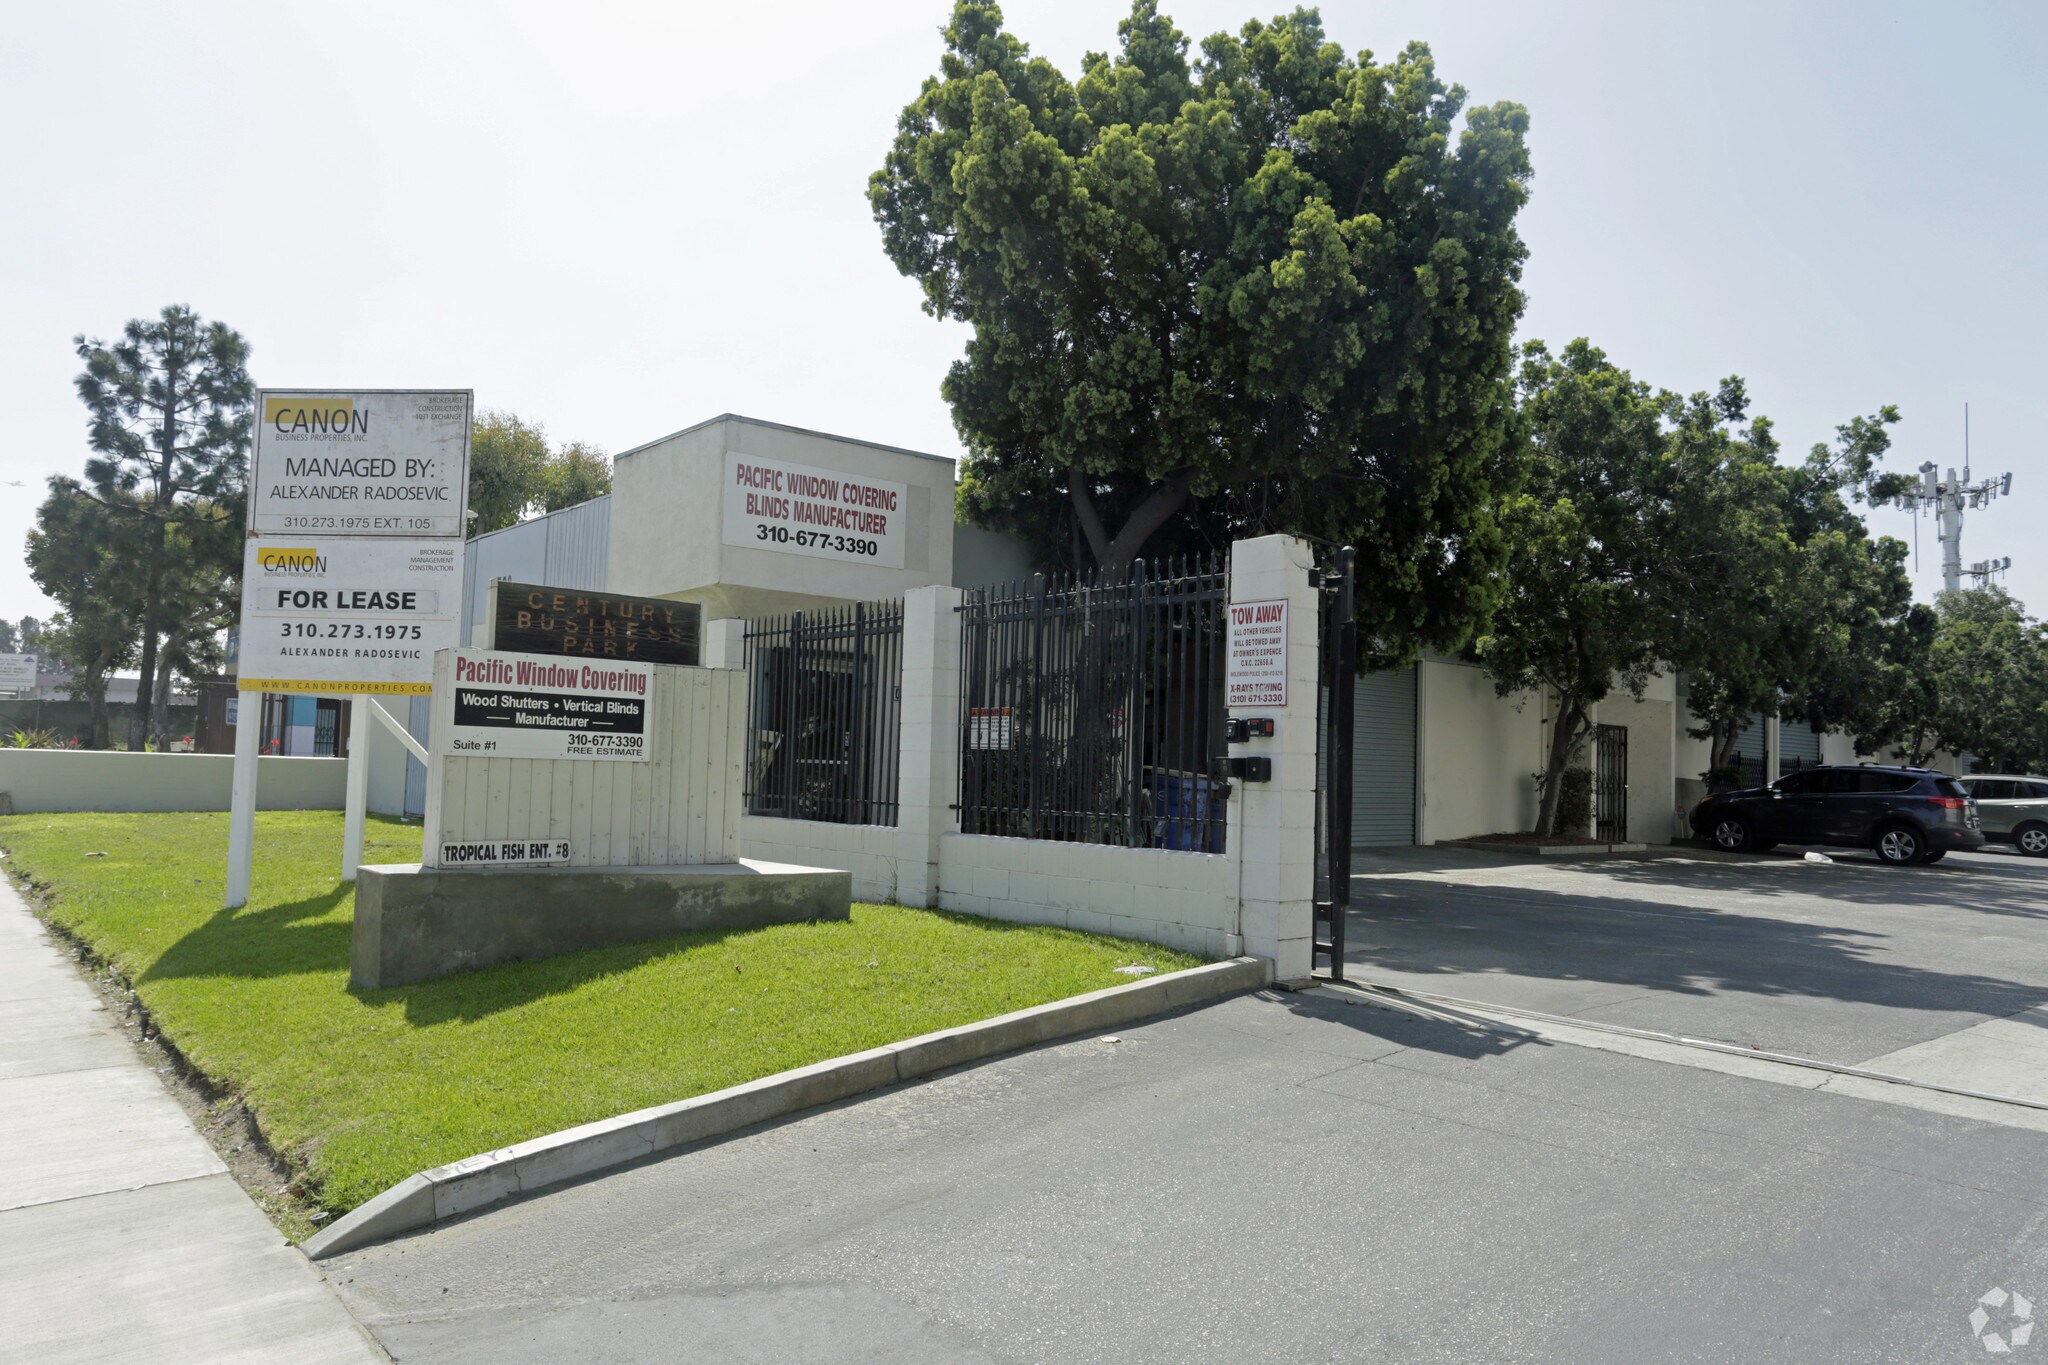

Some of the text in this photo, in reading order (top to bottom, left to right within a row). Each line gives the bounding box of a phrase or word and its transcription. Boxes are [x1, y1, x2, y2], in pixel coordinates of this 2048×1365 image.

[275, 408, 369, 434] CANON
[275, 433, 309, 441] BUSINESS
[285, 458, 436, 478] MANAGED BY:
[270, 485, 449, 501] ALEXANDER RADOSEVIC
[737, 463, 897, 512] PACIFIC WINDOW COVERING
[284, 516, 431, 529] 310.273.1975 EXT. 105
[746, 493, 887, 536] BLINDS MANUFACTURER
[756, 524, 878, 556] 310-677-3390
[264, 554, 327, 573] CANON
[278, 590, 416, 610] FOR LEASE
[528, 592, 674, 624] CENTURY
[1231, 604, 1284, 625] TOW AWAY
[281, 623, 422, 640] 310.273.1975
[517, 611, 681, 643] BUSINESS
[1259, 626, 1282, 634] VEHICLES
[563, 636, 638, 657] PARK
[1252, 638, 1268, 646] TOWED
[1269, 637, 1281, 645] AWAY
[280, 647, 421, 659] ALEXANDER RADOSEVIC
[456, 656, 647, 695] Pacific Window Covering
[1255, 682, 1283, 692] TOWING
[462, 693, 639, 715] Wood Shutters Vertical Blinds
[1230, 695, 1247, 703] (310)
[515, 712, 589, 727] Manufacturer
[453, 740, 497, 750] Suite #1
[568, 734, 643, 748] 310-677-3390
[567, 747, 643, 756] FREE ESTIMATE
[445, 843, 569, 861] TROPICAL FISH ENT. #8
